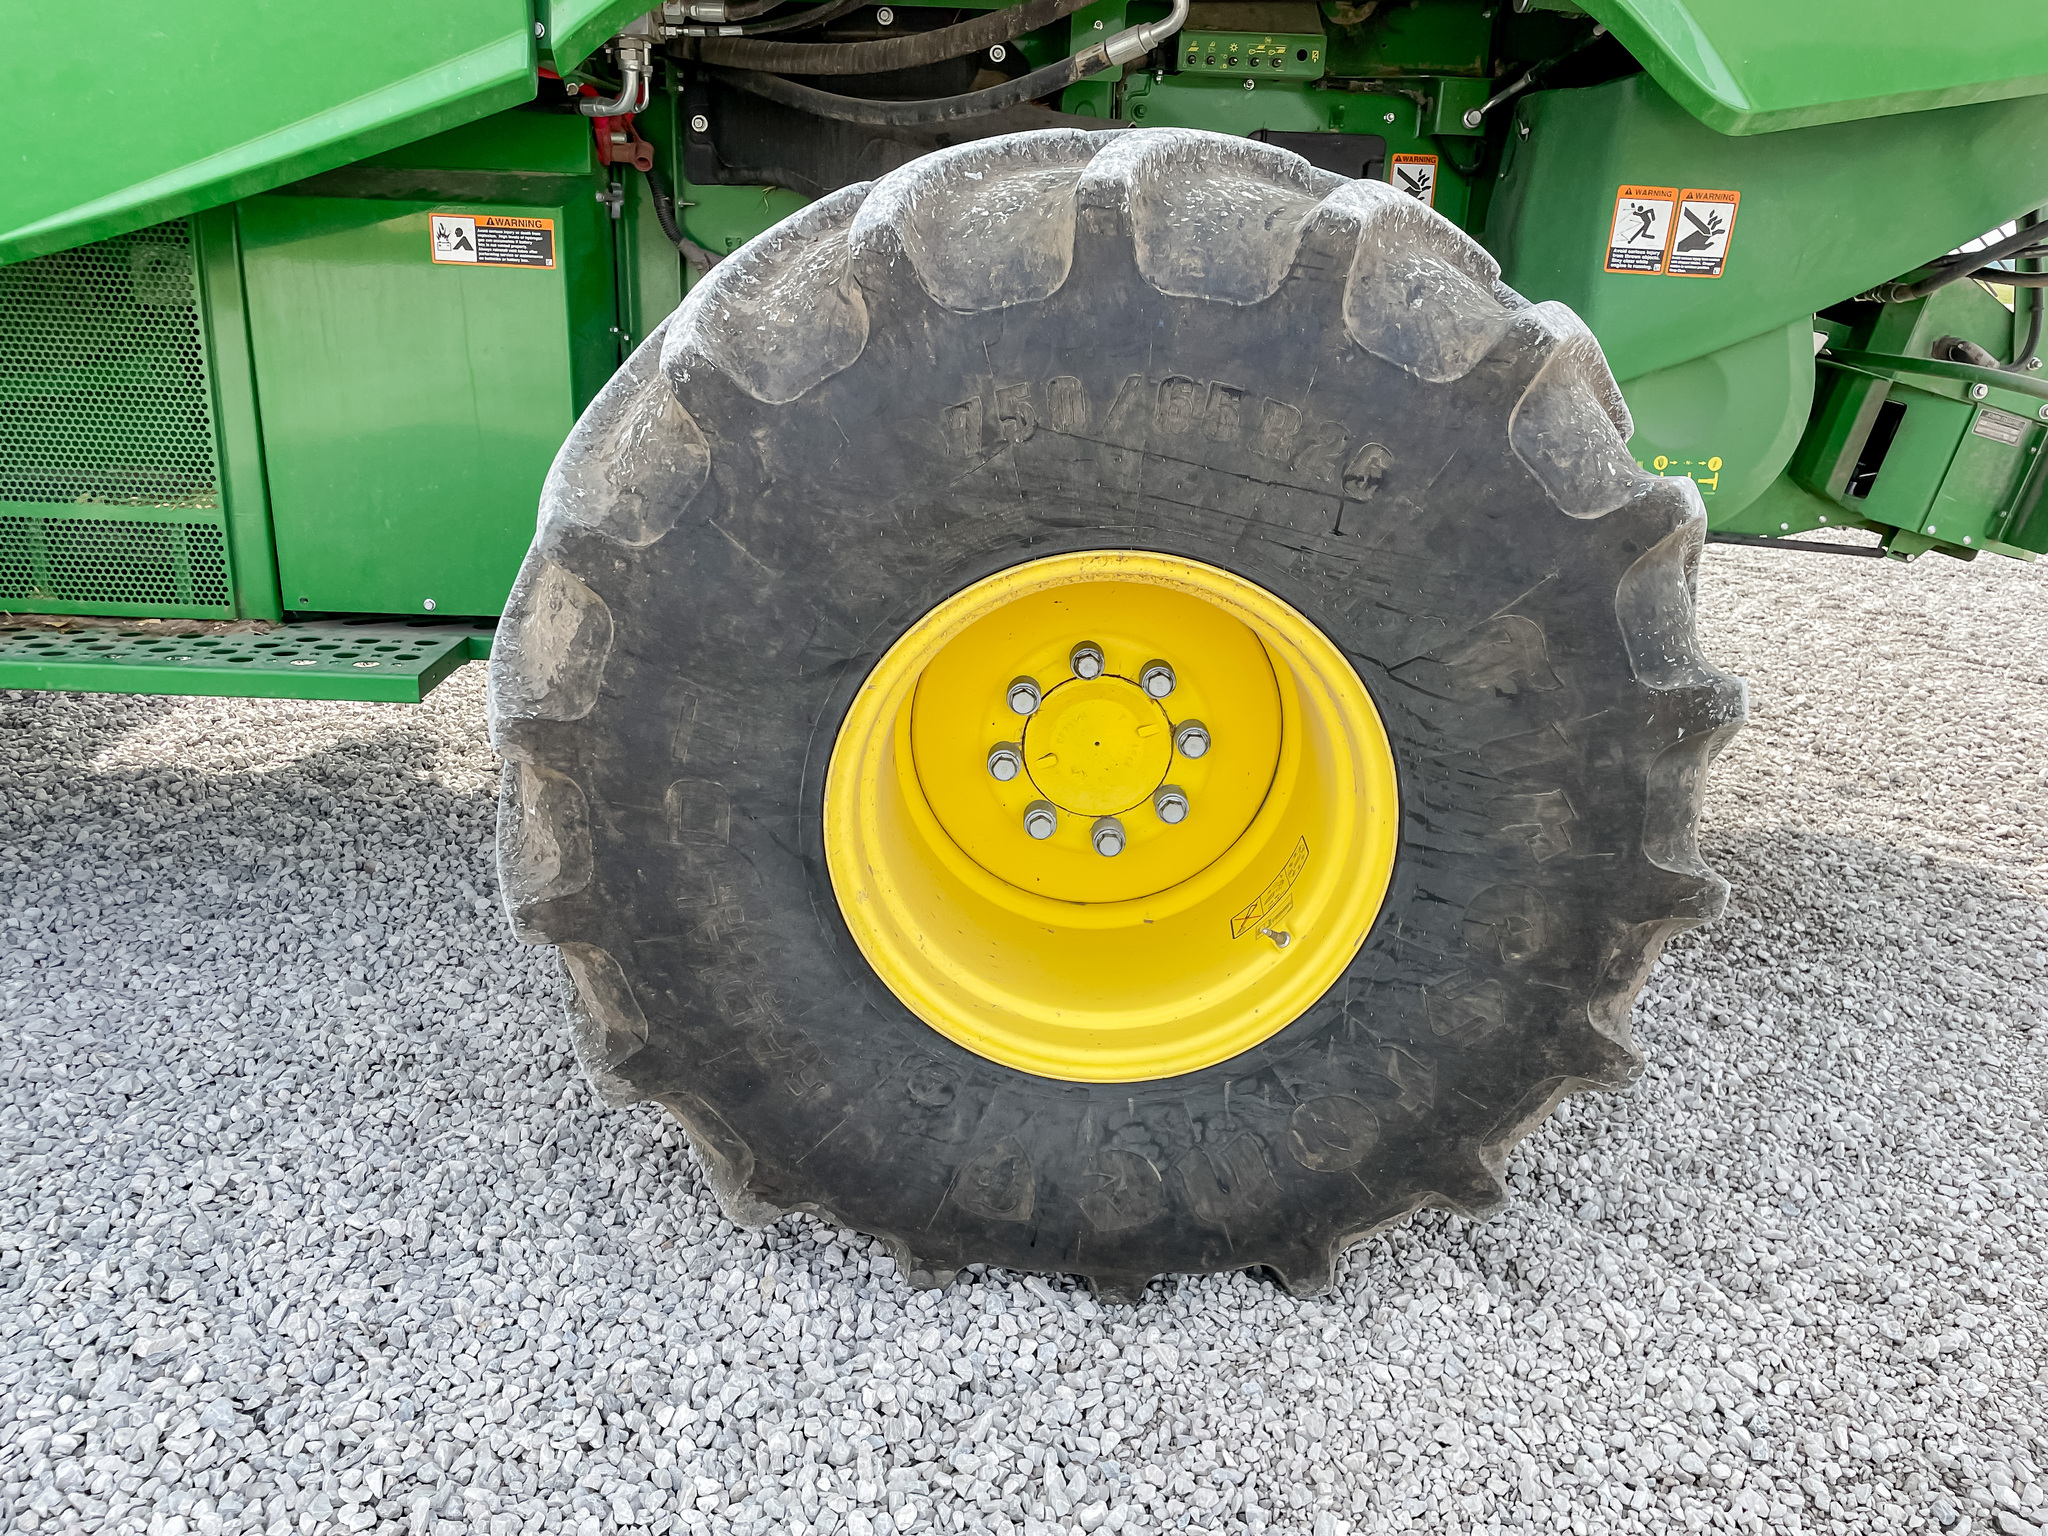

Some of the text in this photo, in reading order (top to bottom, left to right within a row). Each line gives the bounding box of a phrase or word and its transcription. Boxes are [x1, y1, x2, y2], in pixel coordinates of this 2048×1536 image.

[1635, 189, 1672, 198] WARNING
[1695, 192, 1735, 201] WARNING
[495, 218, 542, 228] WARNING
